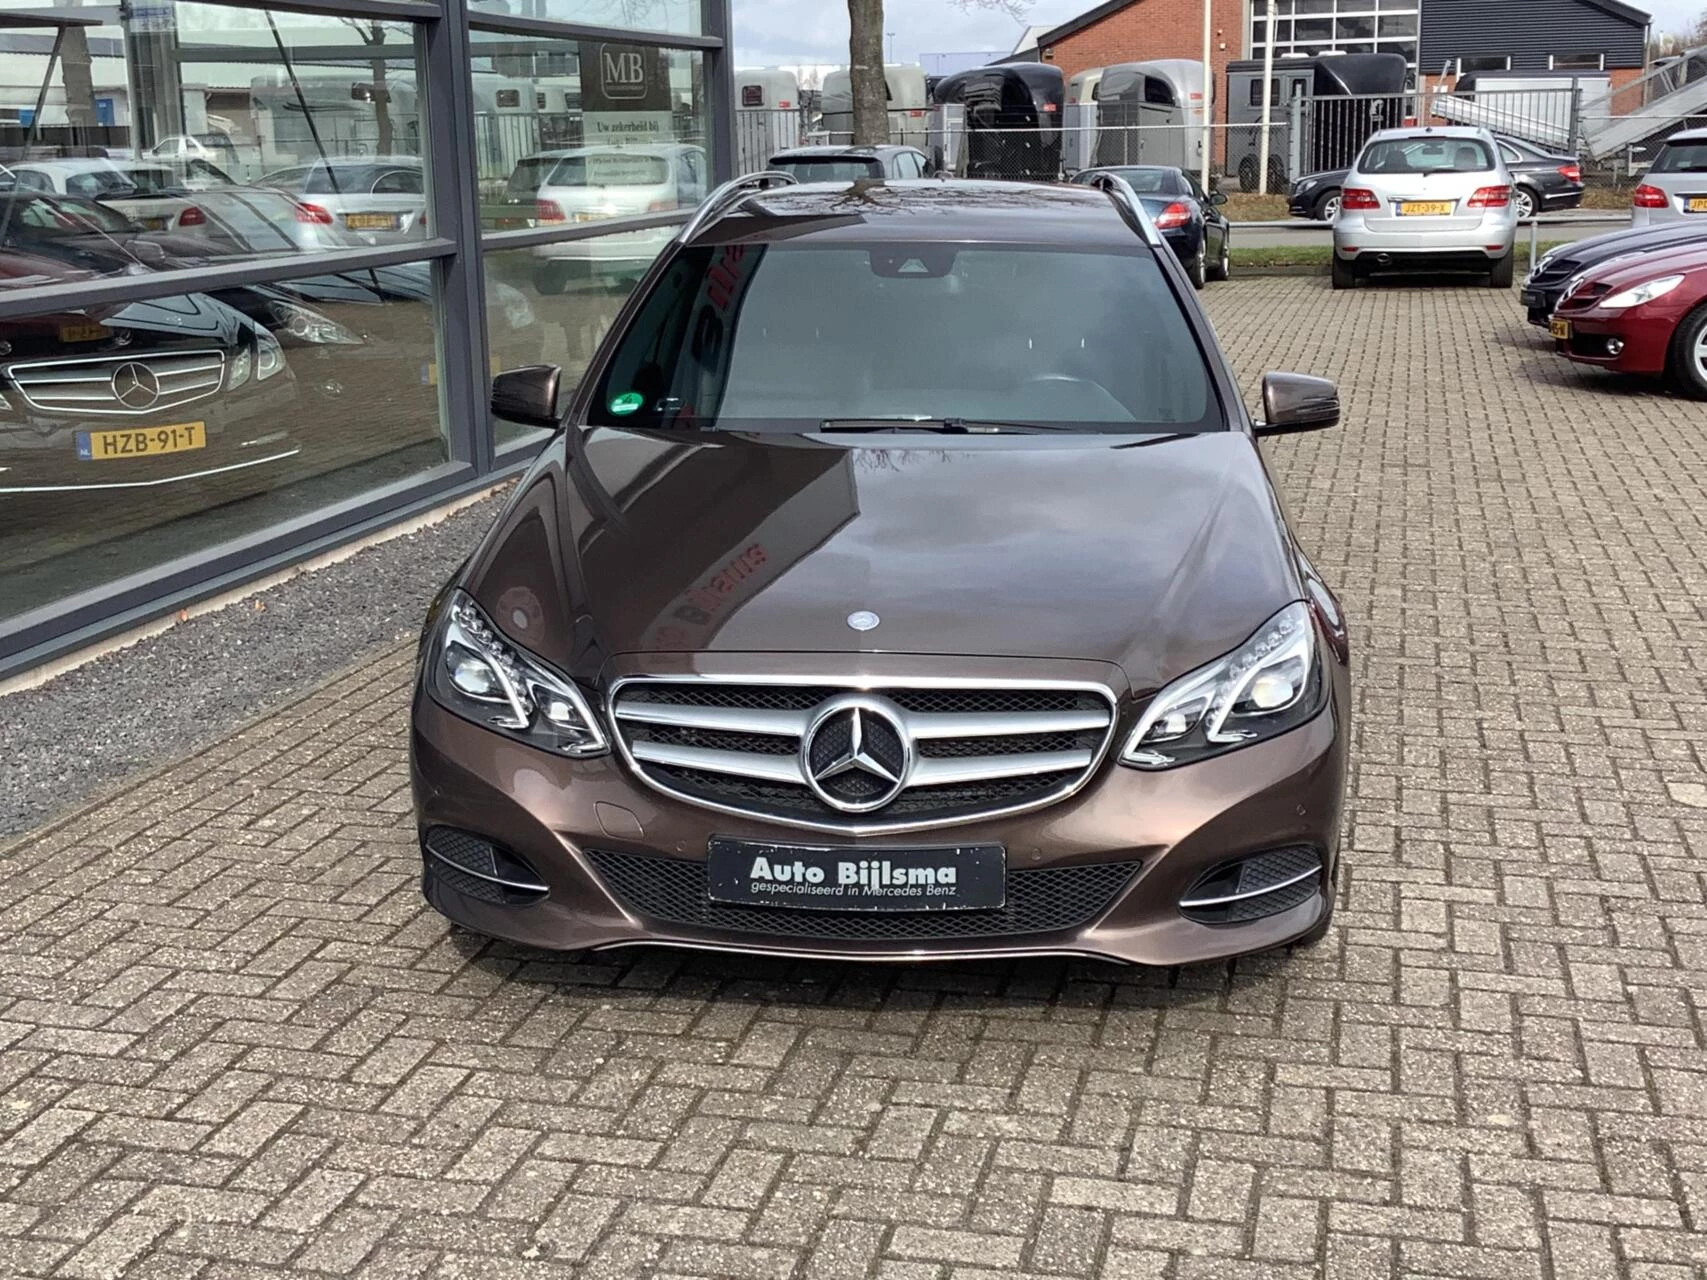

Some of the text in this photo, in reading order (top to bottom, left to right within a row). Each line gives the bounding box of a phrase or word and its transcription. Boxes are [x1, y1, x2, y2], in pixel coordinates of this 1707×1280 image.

[603, 52, 644, 84] MB
[597, 121, 609, 133] Uw
[612, 121, 648, 133] zekerheid
[1404, 203, 1446, 213] JZT-39-X
[102, 426, 196, 455] HZB-91-T
[750, 856, 957, 890] Auto Bijlsma
[751, 881, 956, 897] gespecialiseerd in Mercedes Benz
